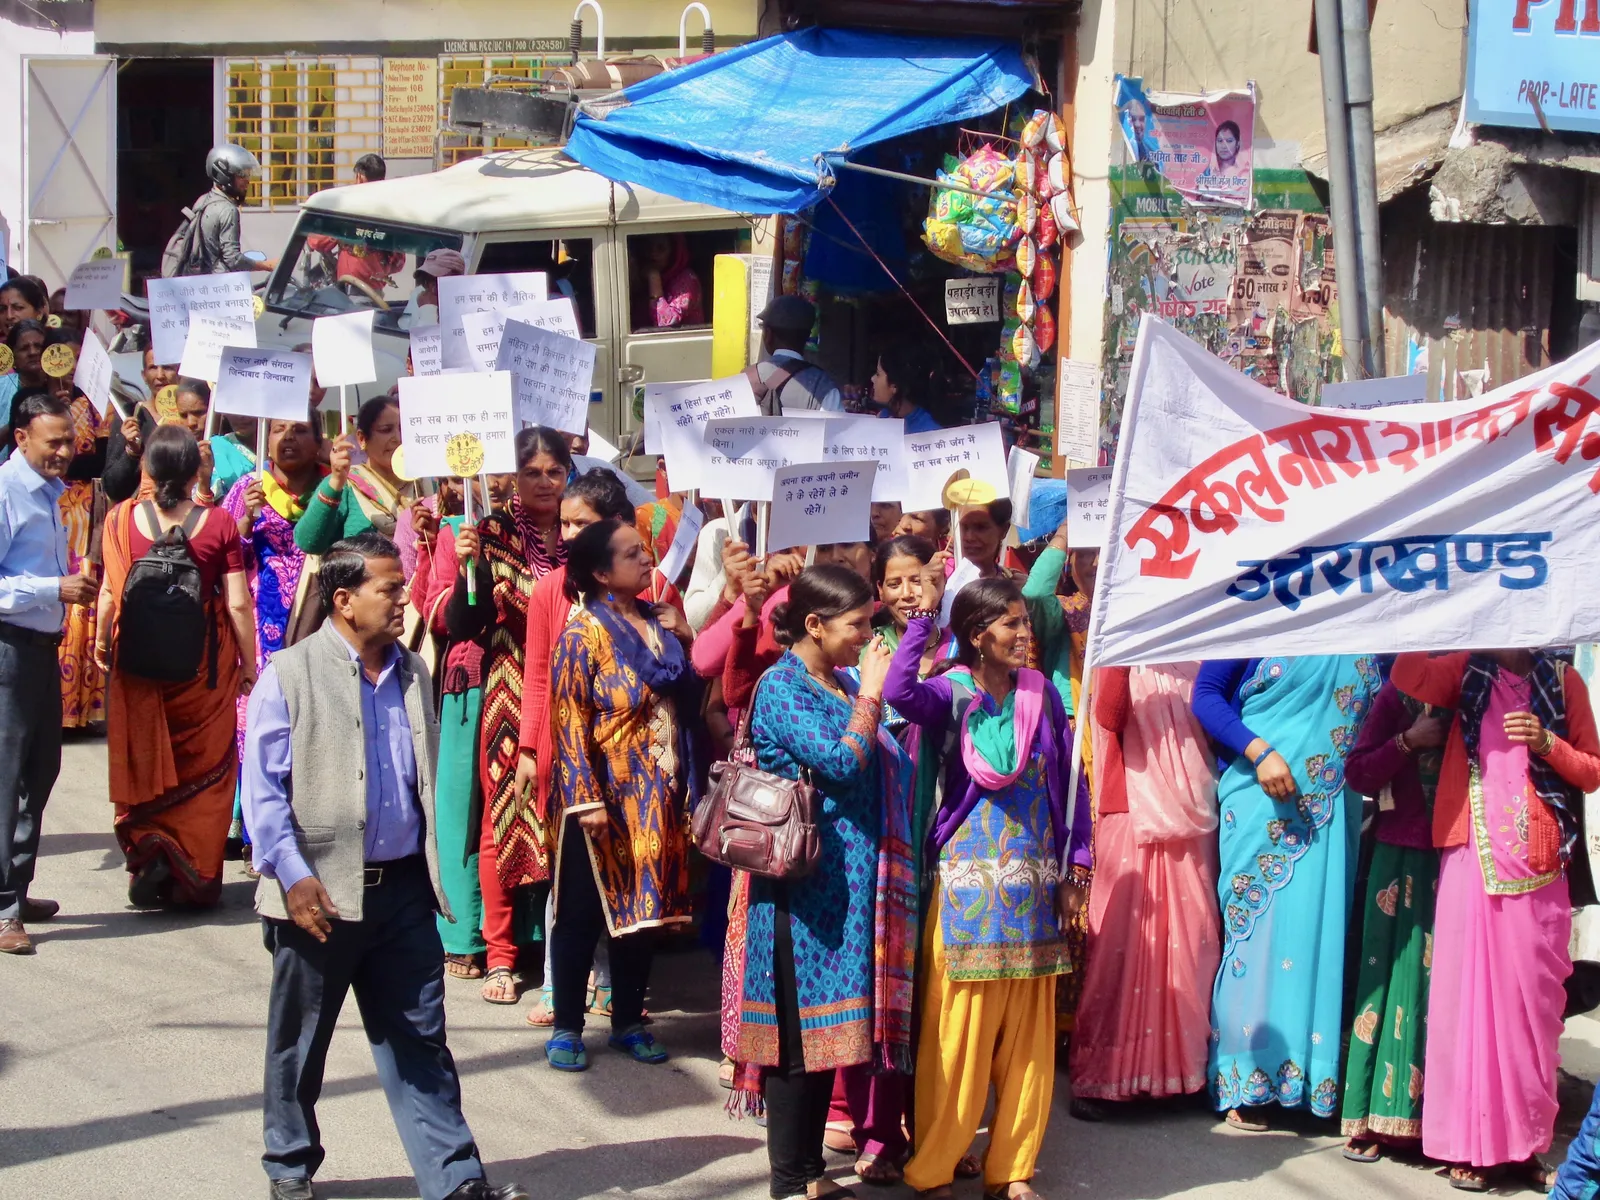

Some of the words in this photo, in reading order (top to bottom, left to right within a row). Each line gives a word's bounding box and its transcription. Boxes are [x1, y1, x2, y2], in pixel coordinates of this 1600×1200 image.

[444, 41, 468, 53] LICENCE
[389, 61, 415, 72] Telephone
[413, 74, 423, 82] 100
[213, 284, 230, 294] पत्नी
[1184, 269, 1215, 296] Vote
[454, 294, 465, 304] हम
[469, 294, 482, 303] सब
[487, 292, 498, 302] की
[502, 291, 509, 302] है
[513, 291, 536, 301] नैतिक
[947, 285, 974, 301] पहाड़ी
[225, 299, 250, 309] बनाइए
[549, 314, 563, 324] एक
[948, 306, 980, 318] उपलब्ध
[543, 346, 566, 362] किसान
[233, 356, 251, 365] एकल
[254, 357, 269, 367] नारी
[271, 359, 294, 371] संगठन
[229, 366, 260, 379] जिन्दाबाद
[263, 370, 296, 383] जिन्दाबाद
[554, 368, 568, 379] शान
[523, 376, 547, 392] पहचान
[559, 387, 587, 403] अस्तित्व
[671, 403, 682, 413] अब
[705, 394, 717, 405] हम
[409, 416, 422, 427] हम
[428, 415, 442, 425] सब
[447, 414, 458, 424] का
[463, 413, 476, 424] एक
[481, 409, 489, 422] ही
[494, 411, 508, 421] नारा
[415, 432, 439, 445] बेहतर
[485, 430, 507, 441] हमारा
[714, 427, 734, 436] एकल
[739, 425, 755, 436] नारी
[759, 426, 767, 437] के
[772, 427, 799, 438] सहयोग
[832, 444, 839, 455] के
[842, 446, 855, 456] लिए
[857, 446, 868, 456] उठे
[878, 448, 889, 456] हम
[911, 442, 931, 453] पेंशन
[935, 438, 946, 449] की
[949, 437, 965, 447] जंग
[968, 434, 976, 444] में
[711, 456, 722, 465] हर
[757, 457, 778, 470] अधूरा
[912, 460, 925, 470] हम
[928, 457, 942, 467] सब
[945, 454, 960, 464] संग
[780, 477, 798, 487] अपना
[801, 475, 814, 485] हक
[816, 472, 836, 482] अपनी
[839, 470, 860, 480] जमीन
[1087, 474, 1098, 482] हम
[785, 490, 793, 503] ले
[796, 488, 805, 501] के
[829, 486, 837, 498] ले
[840, 485, 849, 497] के
[1077, 500, 1094, 509] बहन
[1124, 432, 1289, 580] एकल
[1083, 512, 1091, 522] भी
[1226, 530, 1553, 611] उत्तराखण्ड
